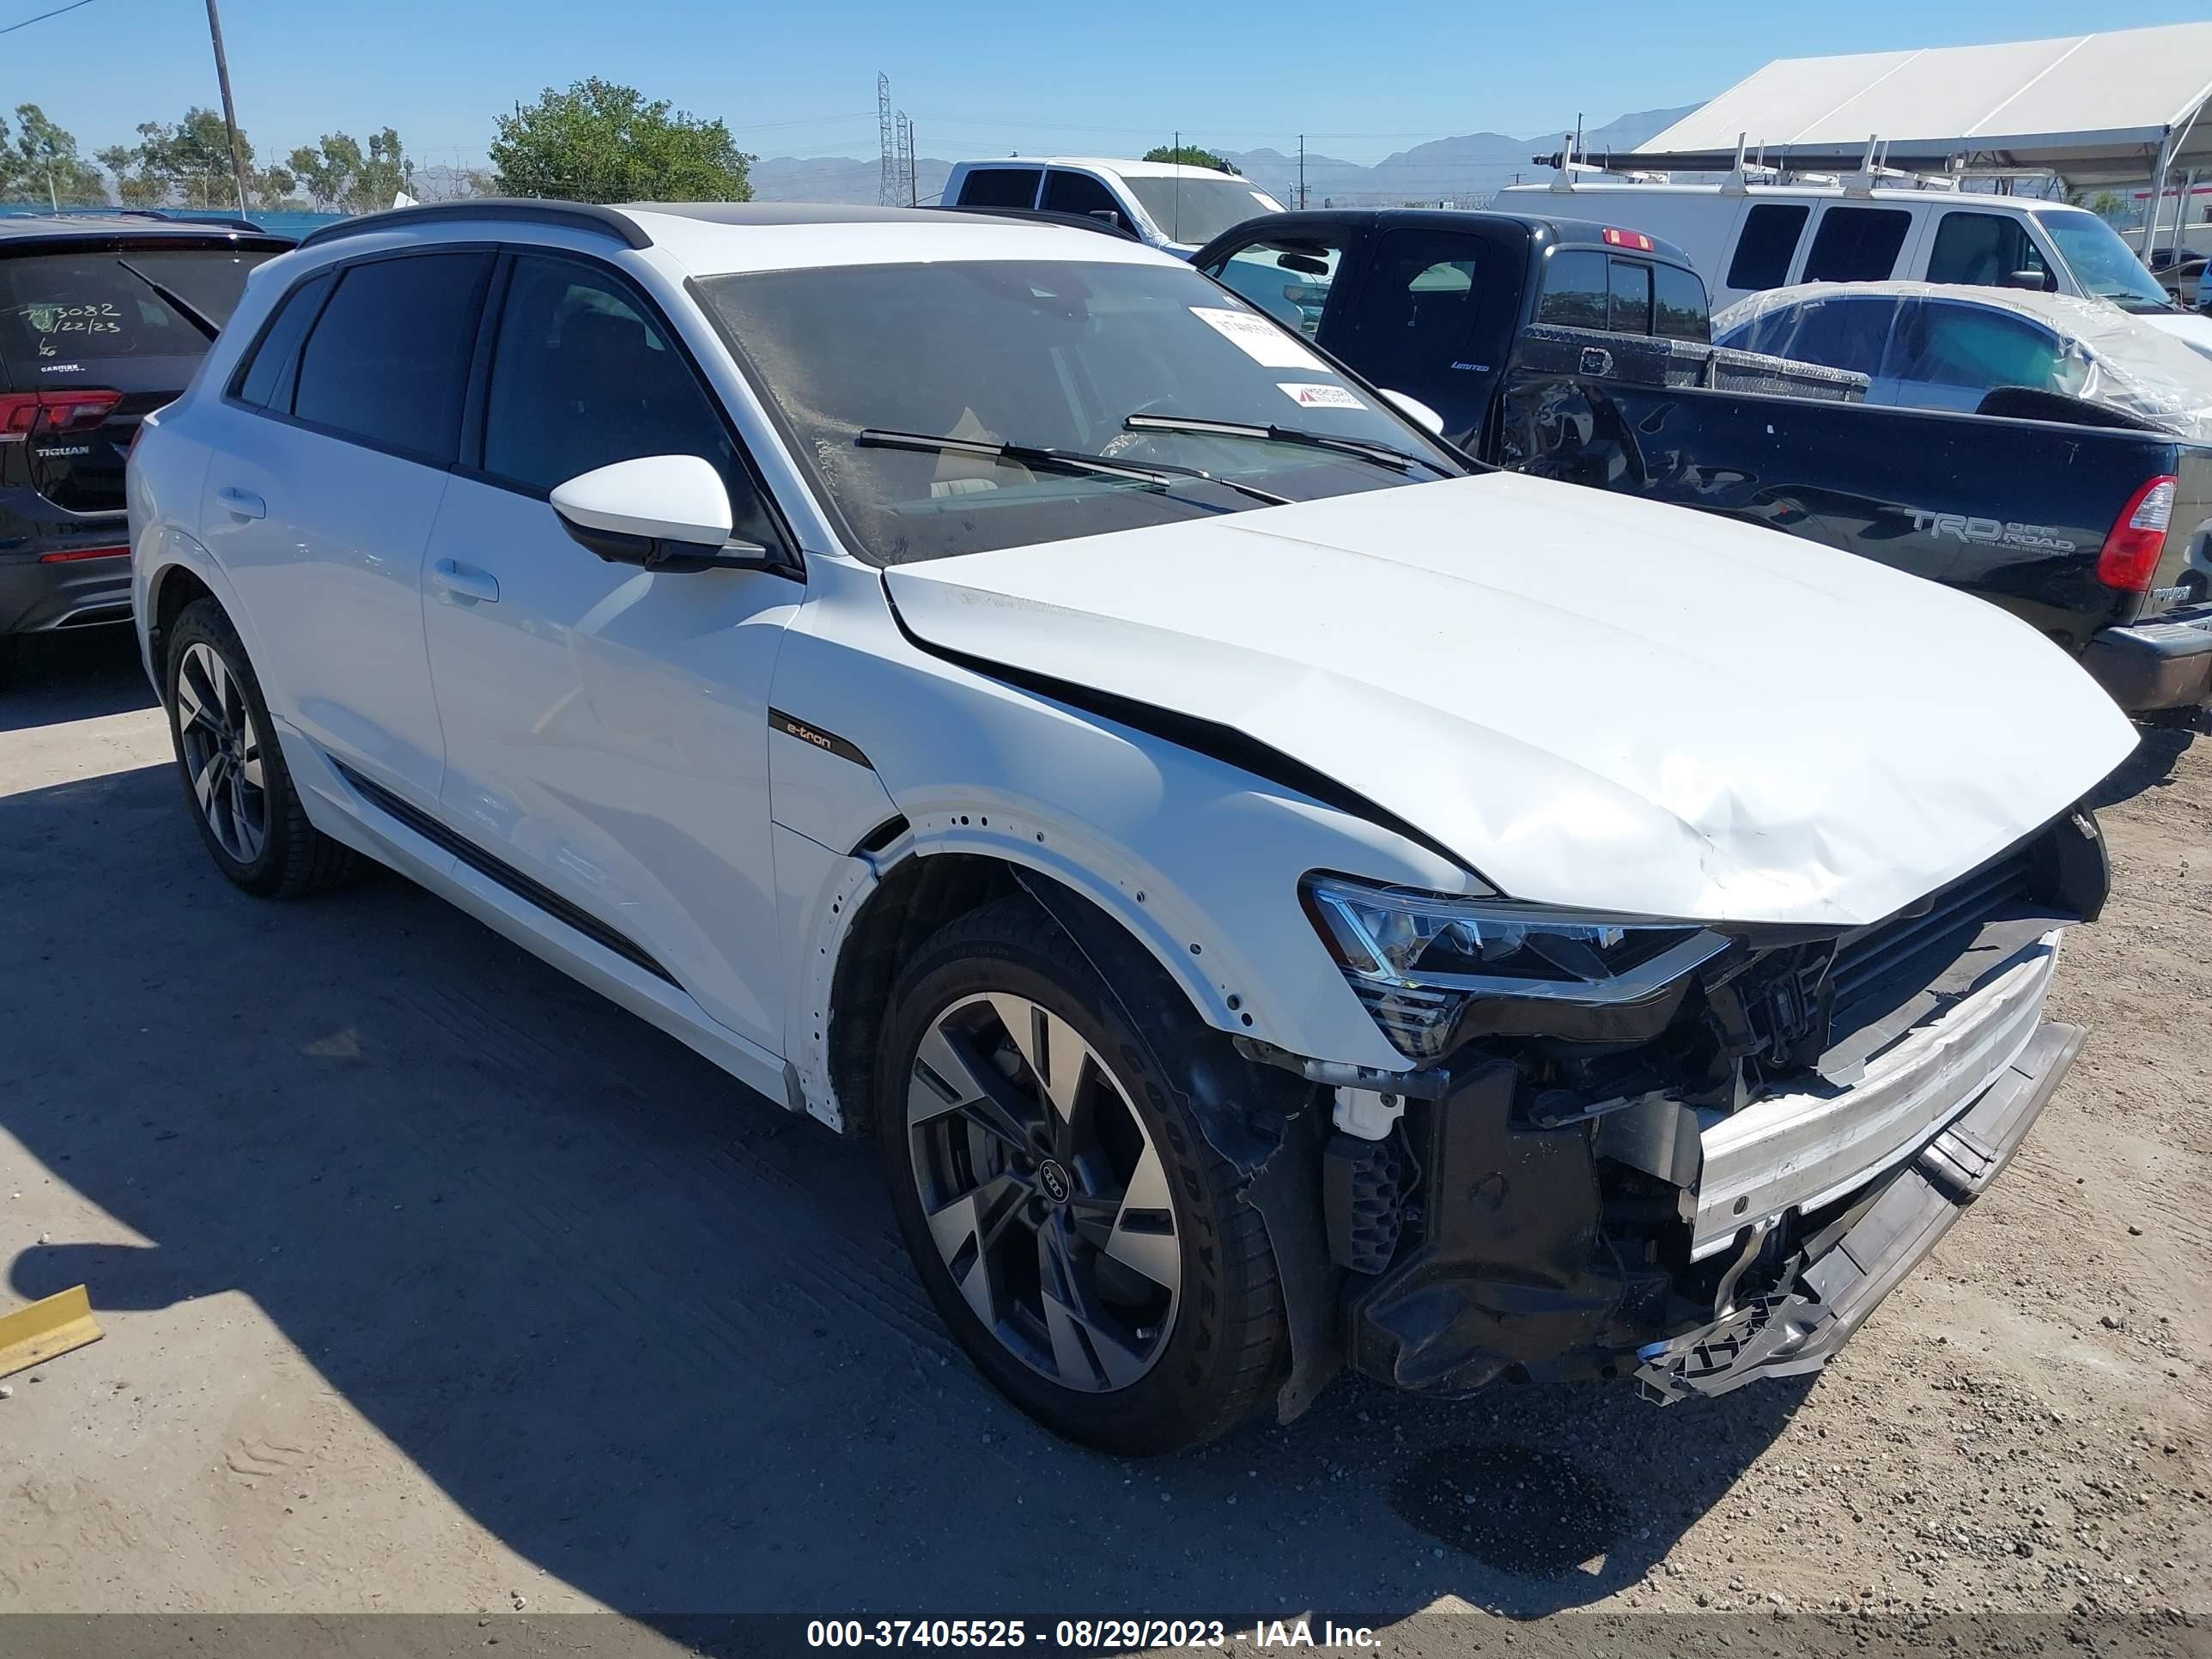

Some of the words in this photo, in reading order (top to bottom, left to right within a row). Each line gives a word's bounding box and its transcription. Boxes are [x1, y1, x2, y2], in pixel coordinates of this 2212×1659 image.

[35, 446, 89, 458] TIGUAN
[1904, 508, 2003, 544] TRD
[2006, 522, 2060, 537] OFF
[1972, 538, 1996, 548] TOYOTA
[2003, 532, 2076, 552] ROAD
[787, 722, 831, 749] e-tron
